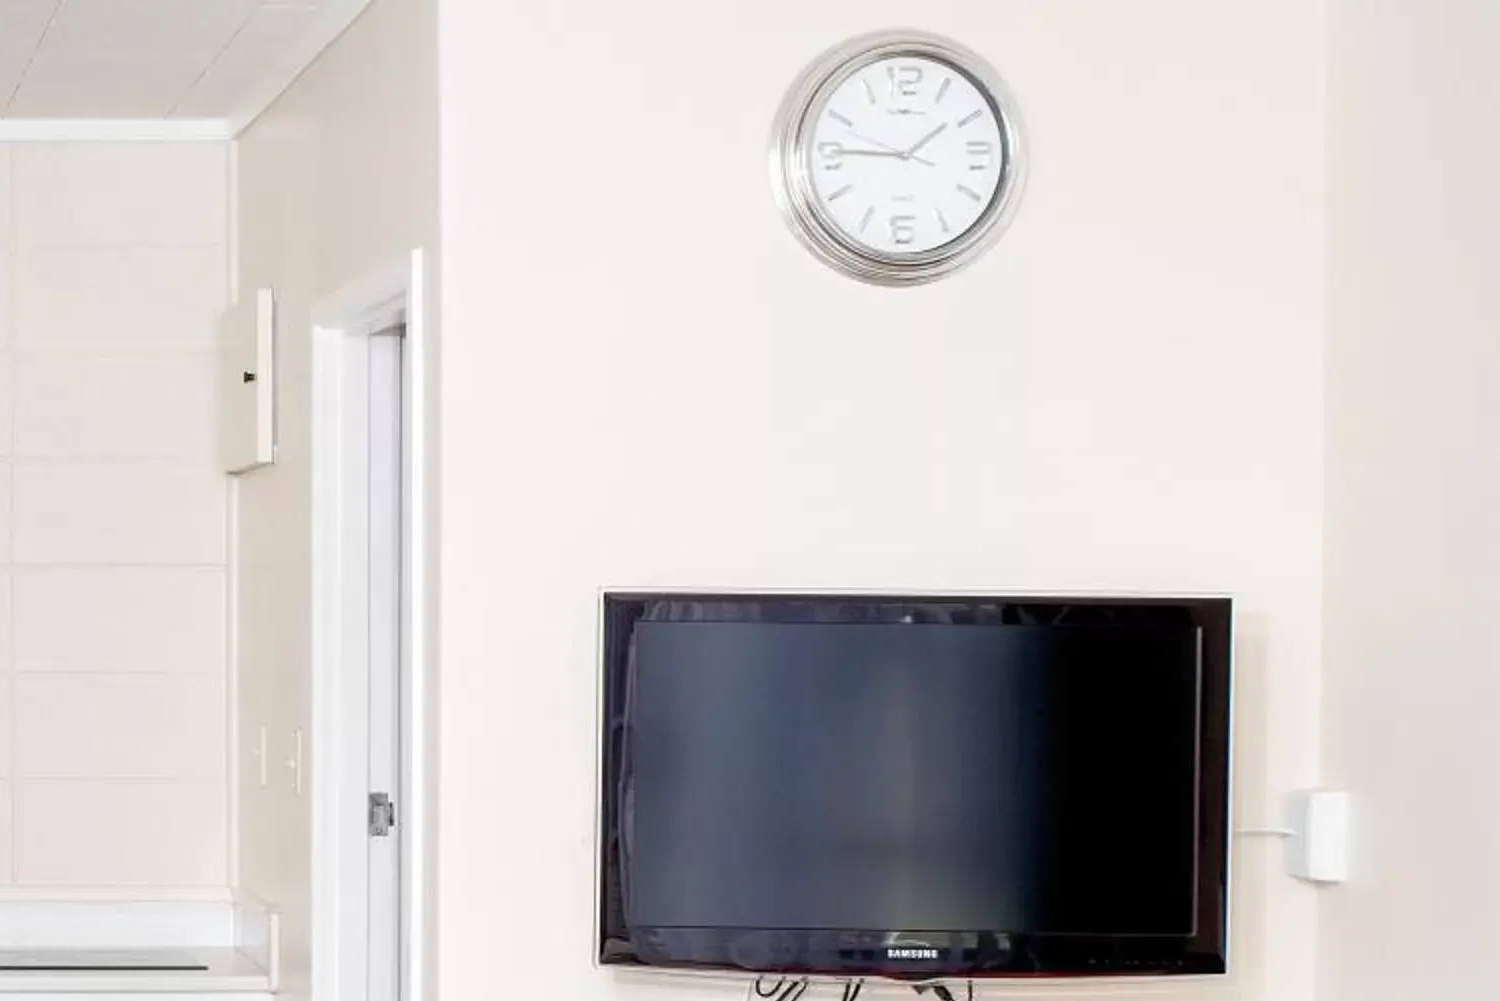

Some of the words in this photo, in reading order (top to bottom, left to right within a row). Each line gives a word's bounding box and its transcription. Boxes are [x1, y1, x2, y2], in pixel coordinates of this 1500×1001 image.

[887, 66, 924, 97] 12
[817, 141, 844, 171] 9
[965, 141, 992, 171] 3
[888, 214, 917, 245] 6
[887, 949, 939, 959] SAMSUNG
